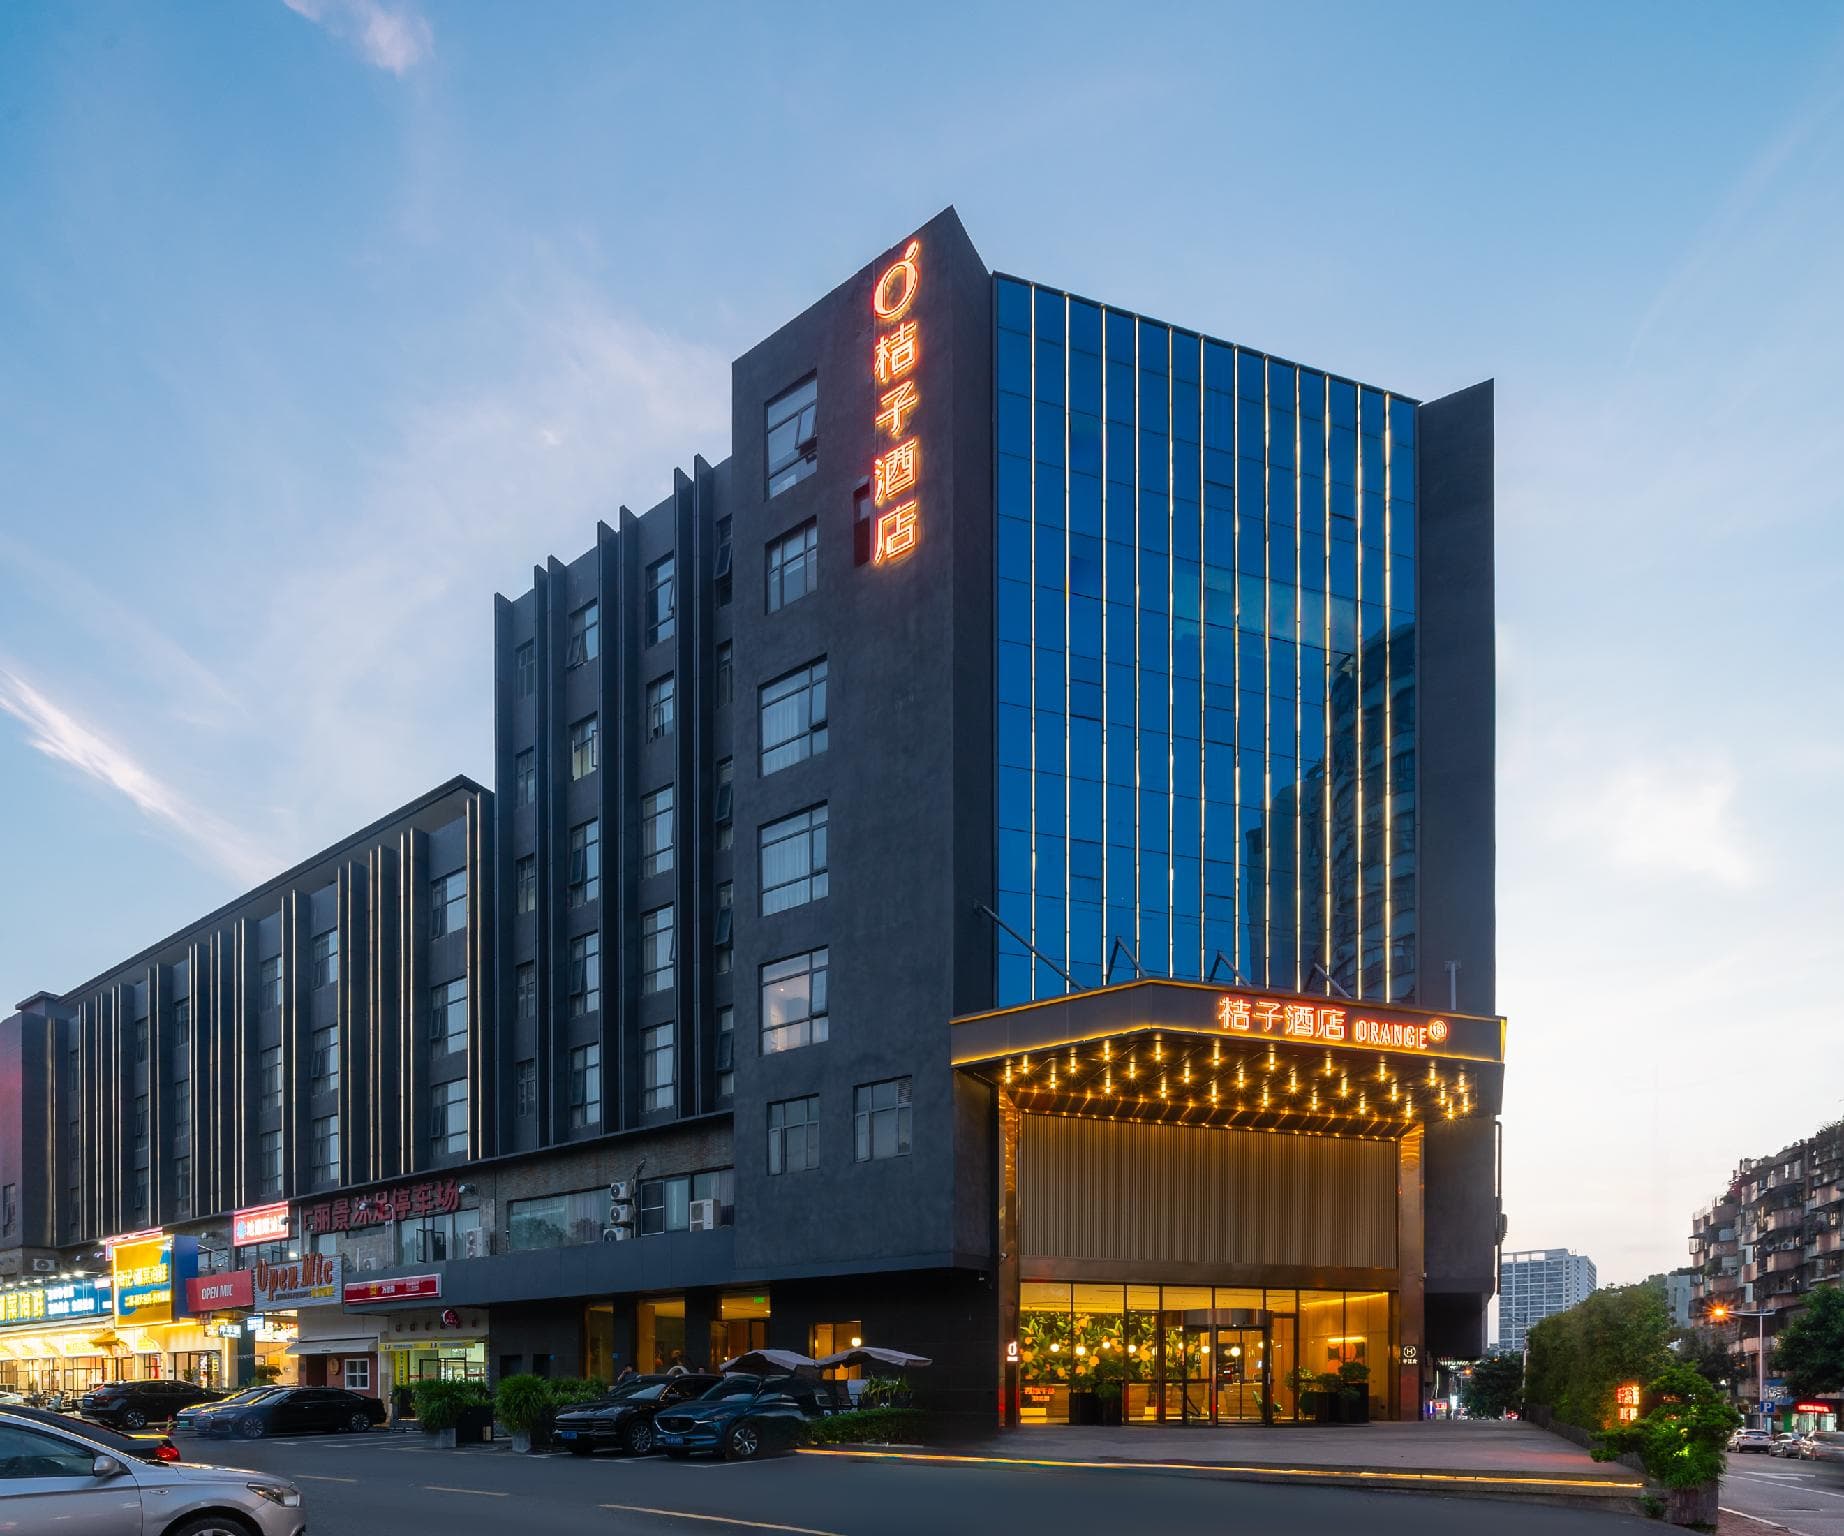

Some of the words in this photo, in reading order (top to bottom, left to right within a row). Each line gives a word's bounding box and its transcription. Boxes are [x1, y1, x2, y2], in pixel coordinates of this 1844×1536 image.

[873, 321, 918, 565] 桔子酒店
[1218, 997, 1347, 1041] 桔子酒店
[1355, 1019, 1428, 1050] ORANGE
[201, 1286, 219, 1300] OPEN
[219, 1284, 233, 1298] MIC
[256, 1258, 299, 1300] Open
[301, 1252, 333, 1287] Mic
[1763, 1402, 1772, 1412] P
